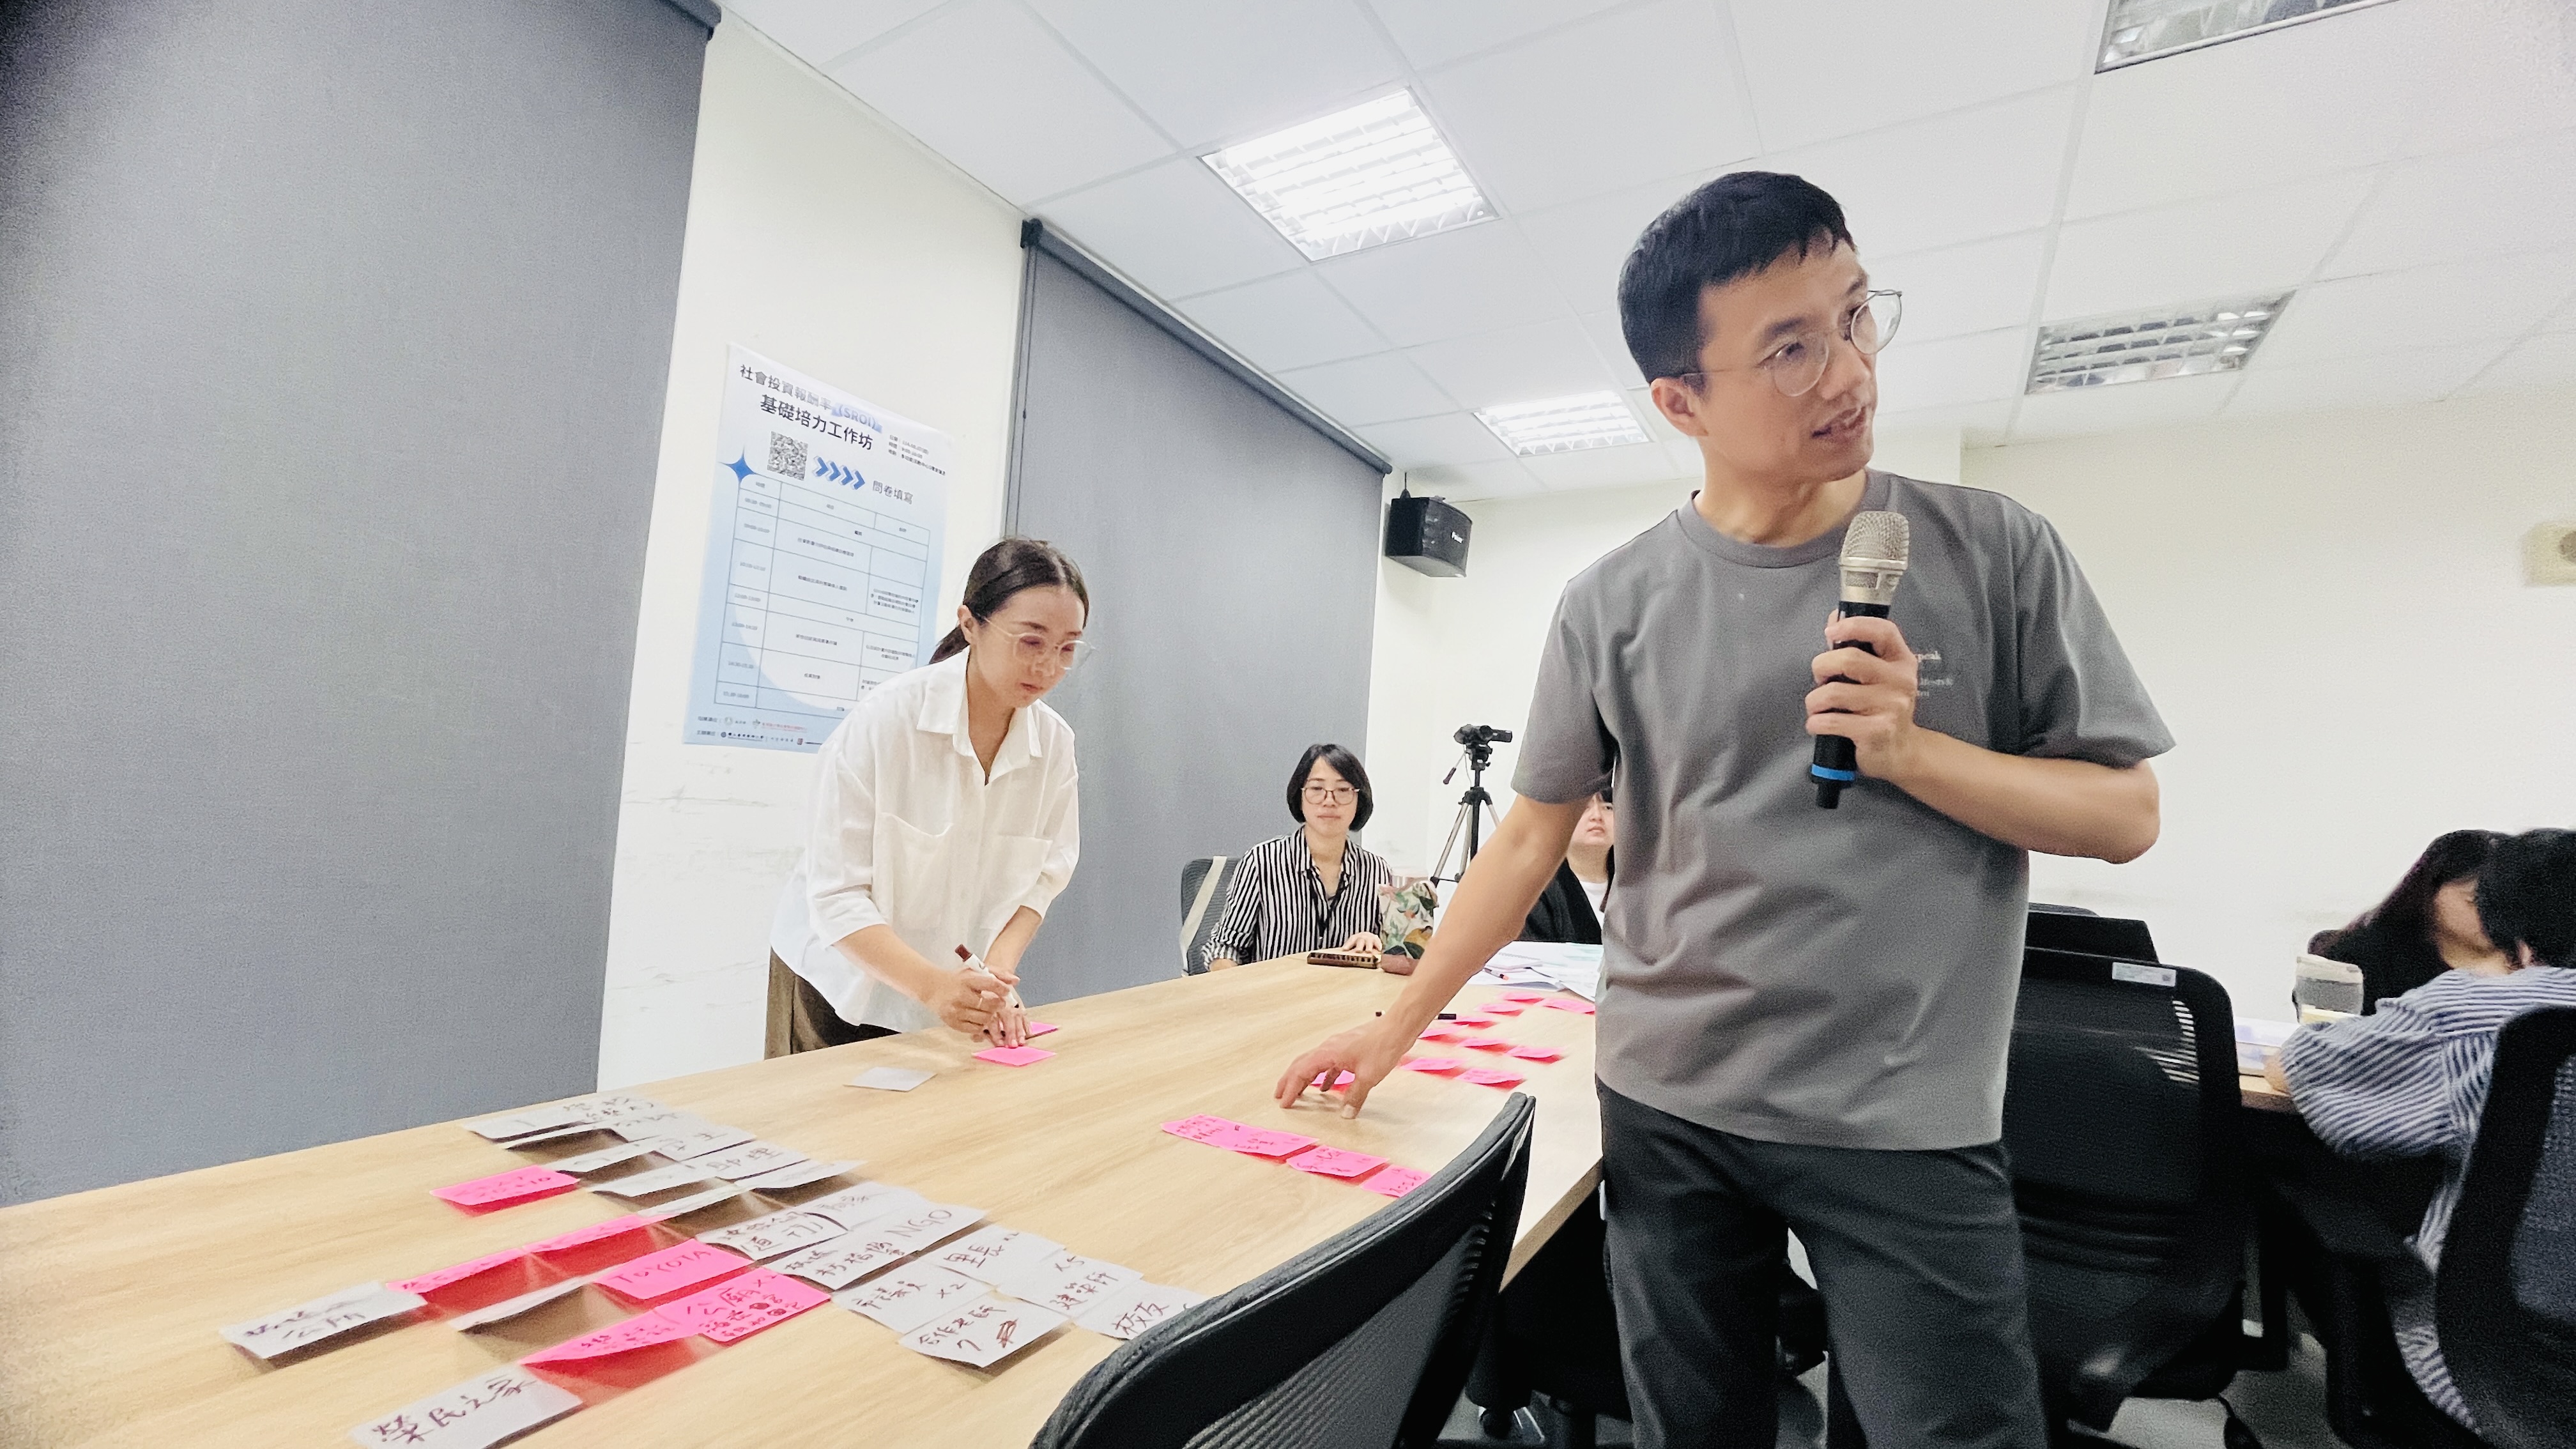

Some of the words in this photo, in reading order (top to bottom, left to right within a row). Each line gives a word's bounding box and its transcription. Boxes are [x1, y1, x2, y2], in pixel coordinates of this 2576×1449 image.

[760, 393, 873, 451] 基礎培力工作坊
[884, 1209, 953, 1238] NGO
[371, 1374, 538, 1445] 榮民之家
